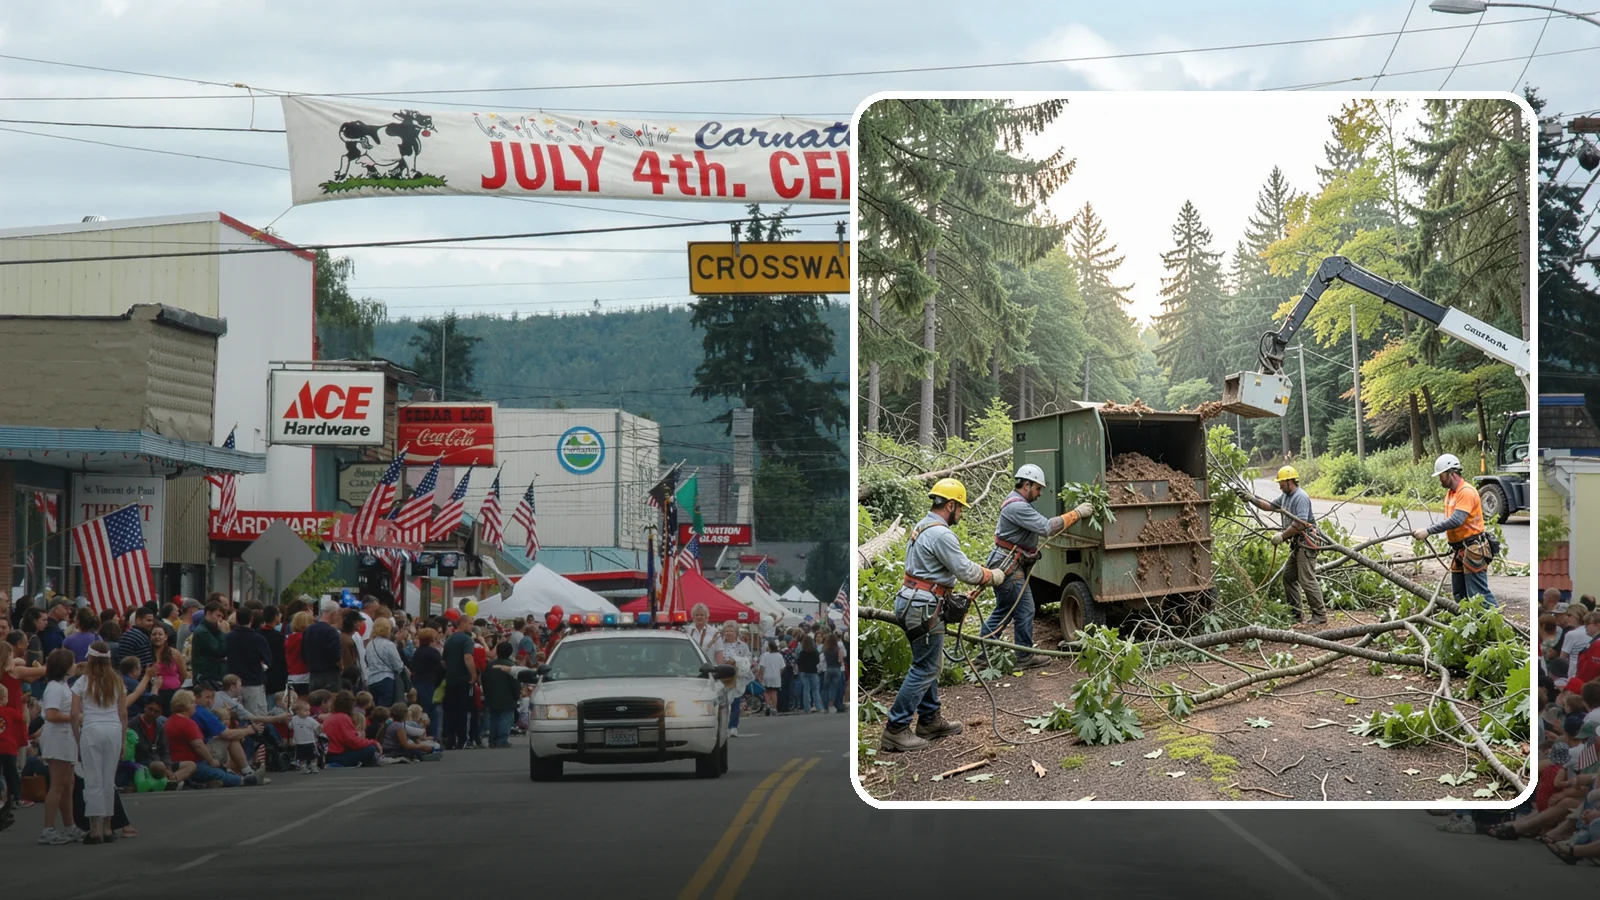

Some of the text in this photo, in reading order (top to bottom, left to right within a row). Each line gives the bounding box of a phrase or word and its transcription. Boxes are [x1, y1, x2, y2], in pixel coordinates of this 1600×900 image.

[695, 122, 850, 149] Carnat
[481, 141, 605, 192] JULY
[632, 150, 746, 197] 4th.
[283, 380, 373, 419] ACE
[406, 410, 452, 421] CEDAR
[284, 421, 370, 436] Hardware
[416, 428, 477, 446] Coca-Cola
[354, 467, 386, 481] Simpl
[96, 486, 124, 494] Vincent
[126, 486, 135, 494] de
[138, 486, 155, 495] Paul
[81, 503, 153, 521] THT
[699, 535, 729, 543] GLASS
